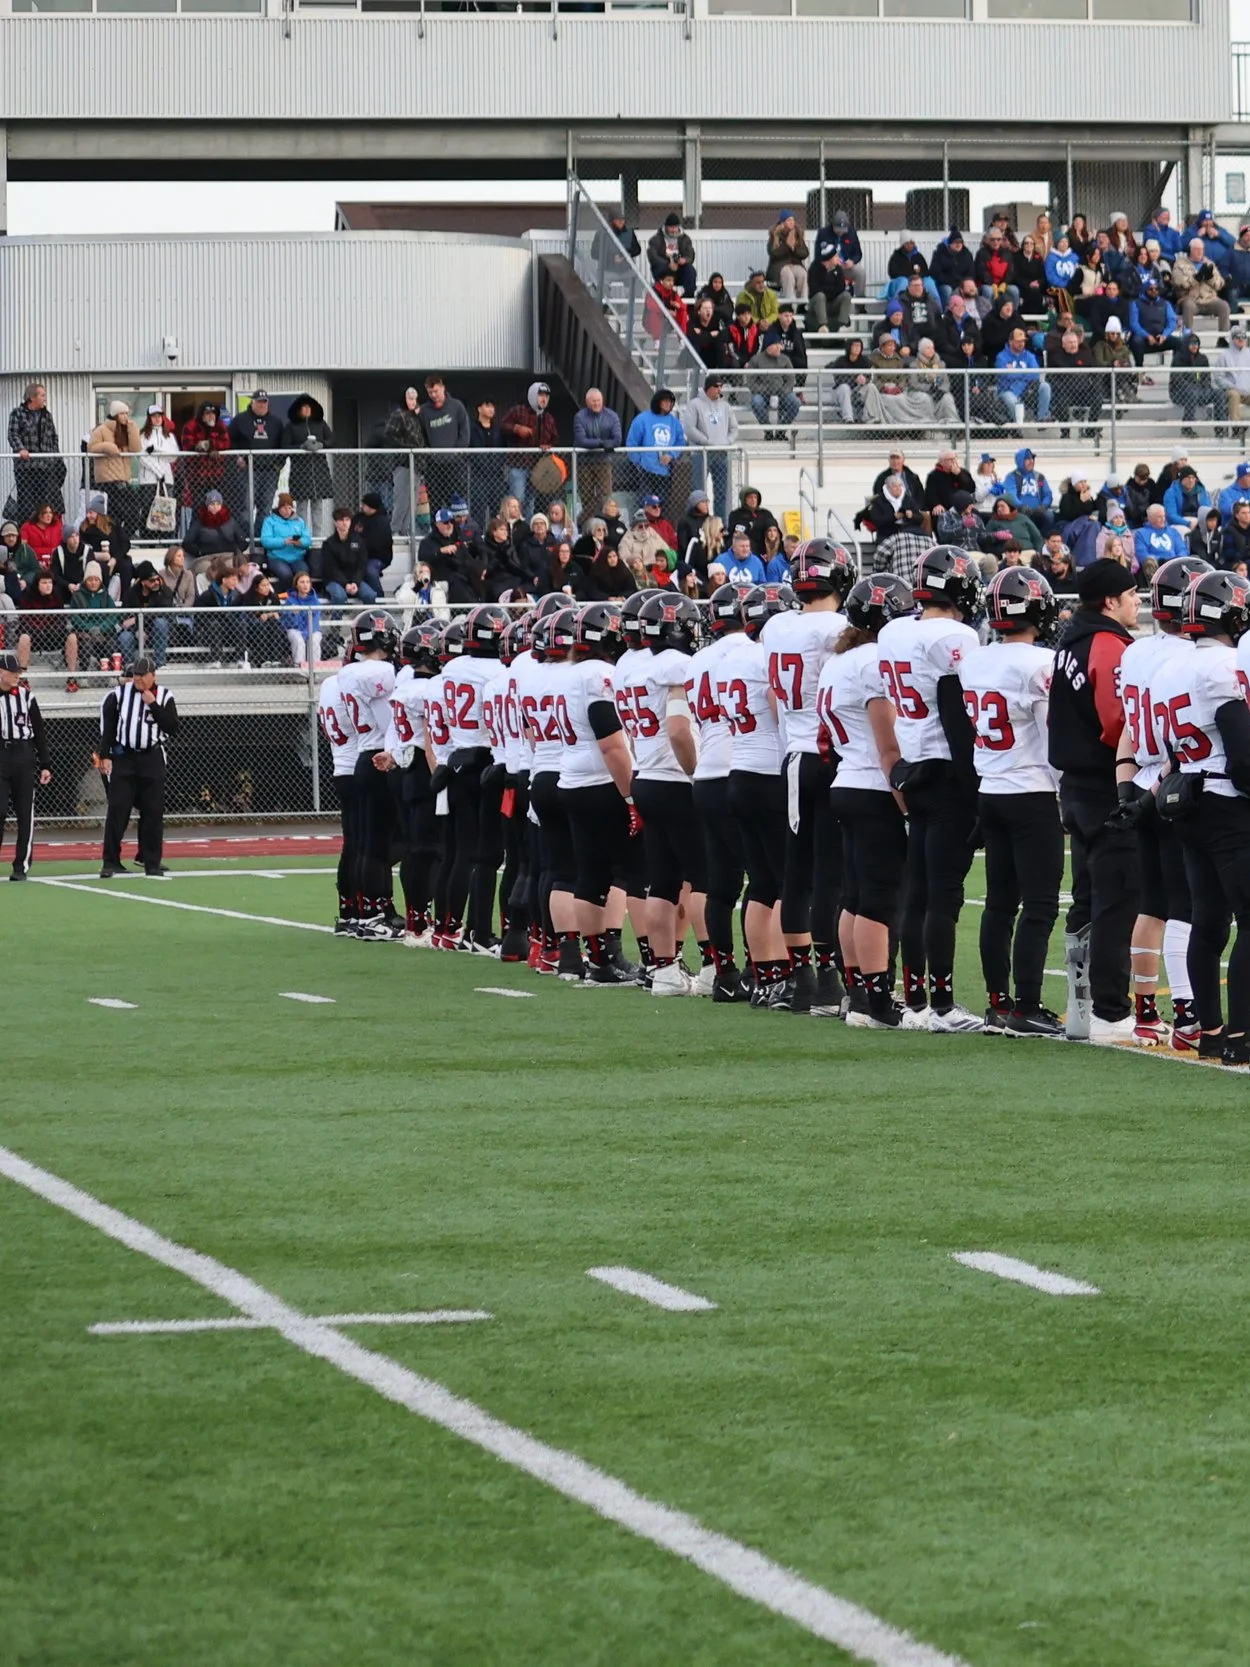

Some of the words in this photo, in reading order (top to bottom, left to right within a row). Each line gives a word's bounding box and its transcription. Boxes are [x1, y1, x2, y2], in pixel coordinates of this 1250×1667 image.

[953, 557, 967, 577] S
[1028, 580, 1042, 599] S
[766, 587, 778, 602] S
[870, 586, 885, 605] S
[1232, 586, 1245, 607] S
[768, 652, 804, 711] 47
[952, 650, 960, 661] S
[443, 680, 479, 729] 82
[684, 671, 721, 730] 54
[717, 678, 757, 737] 53
[817, 686, 850, 746] 11
[879, 660, 930, 720] 35
[1123, 684, 1159, 756] 31
[1154, 693, 1212, 764] 25
